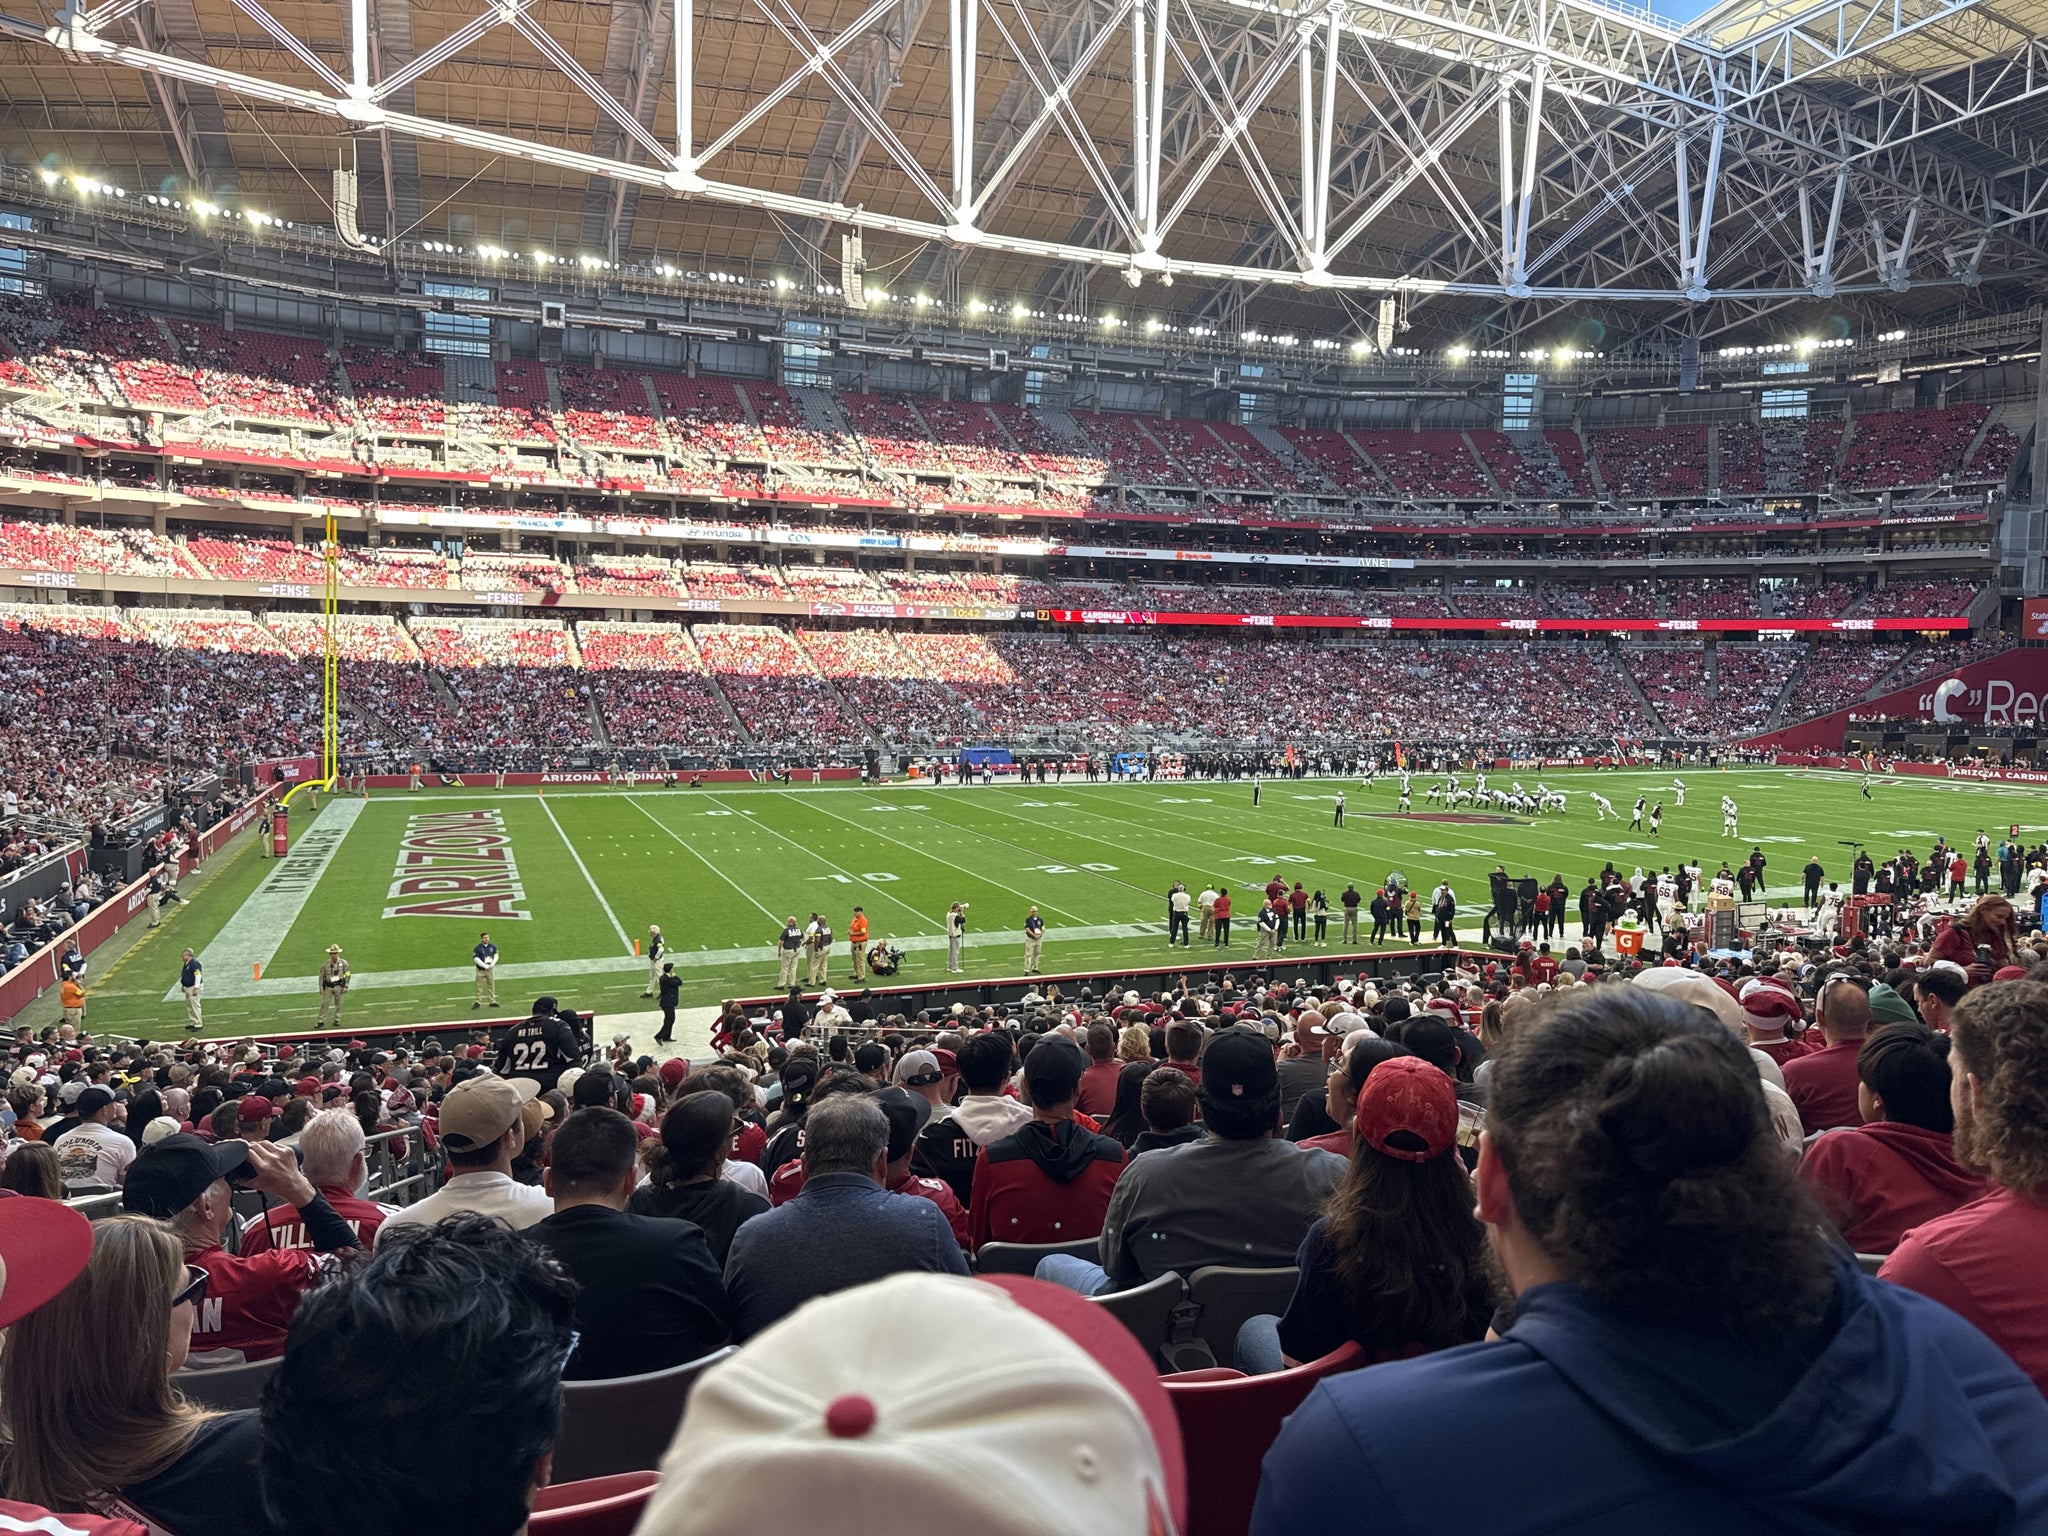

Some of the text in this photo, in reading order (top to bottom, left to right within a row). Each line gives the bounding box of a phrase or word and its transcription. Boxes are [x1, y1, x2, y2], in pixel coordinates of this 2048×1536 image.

[1907, 515, 1955, 524] CONZELMAN
[703, 530, 744, 539] HYUNDAI
[788, 533, 811, 543] COX
[1357, 558, 1391, 568] AVNET
[854, 605, 895, 614] FALCONS
[906, 606, 914, 616] 0
[941, 608, 947, 617] 1
[953, 608, 980, 618] 10:42
[1064, 611, 1127, 620] 3 CARDINALS
[541, 774, 601, 782] ARIZONA
[2012, 825, 2018, 835] 2
[381, 808, 532, 920] ARIZONA
[1236, 855, 1317, 865] 30
[270, 859, 324, 883] TAKES
[1036, 863, 1120, 874] 20
[1658, 886, 1671, 898] 66
[1716, 886, 1729, 896] 58
[128, 887, 147, 913] ARIZO
[1619, 934, 1632, 948] G
[1546, 969, 1550, 982] 1
[528, 1026, 543, 1036] TRILL
[513, 1040, 549, 1070] 22
[57, 1137, 103, 1152] COLUMBIA
